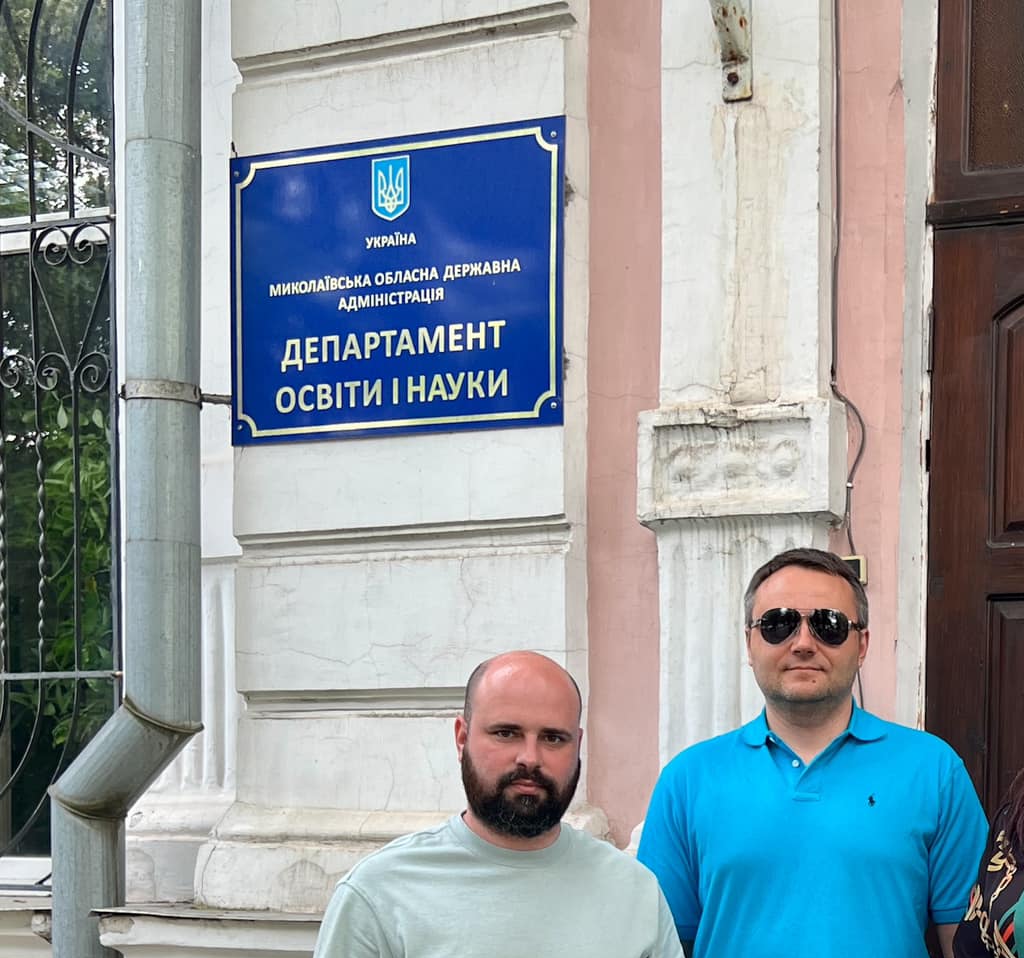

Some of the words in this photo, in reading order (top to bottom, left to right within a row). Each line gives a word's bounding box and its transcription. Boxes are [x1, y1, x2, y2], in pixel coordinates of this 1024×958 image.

[365, 232, 417, 249] УКРАЇНА
[269, 272, 372, 297] МИКОЛАЇВСЬКА
[375, 267, 439, 286] ОБЛАСНА
[443, 258, 521, 281] ДЕРЖАВНА
[338, 287, 445, 312] АДМІНІСТРАЦІЯ
[280, 320, 506, 372] ДЕПАРТАМЕНТ
[275, 379, 382, 414] ОСВІТИ
[392, 377, 399, 404] І
[407, 368, 508, 401] НАУКИ
